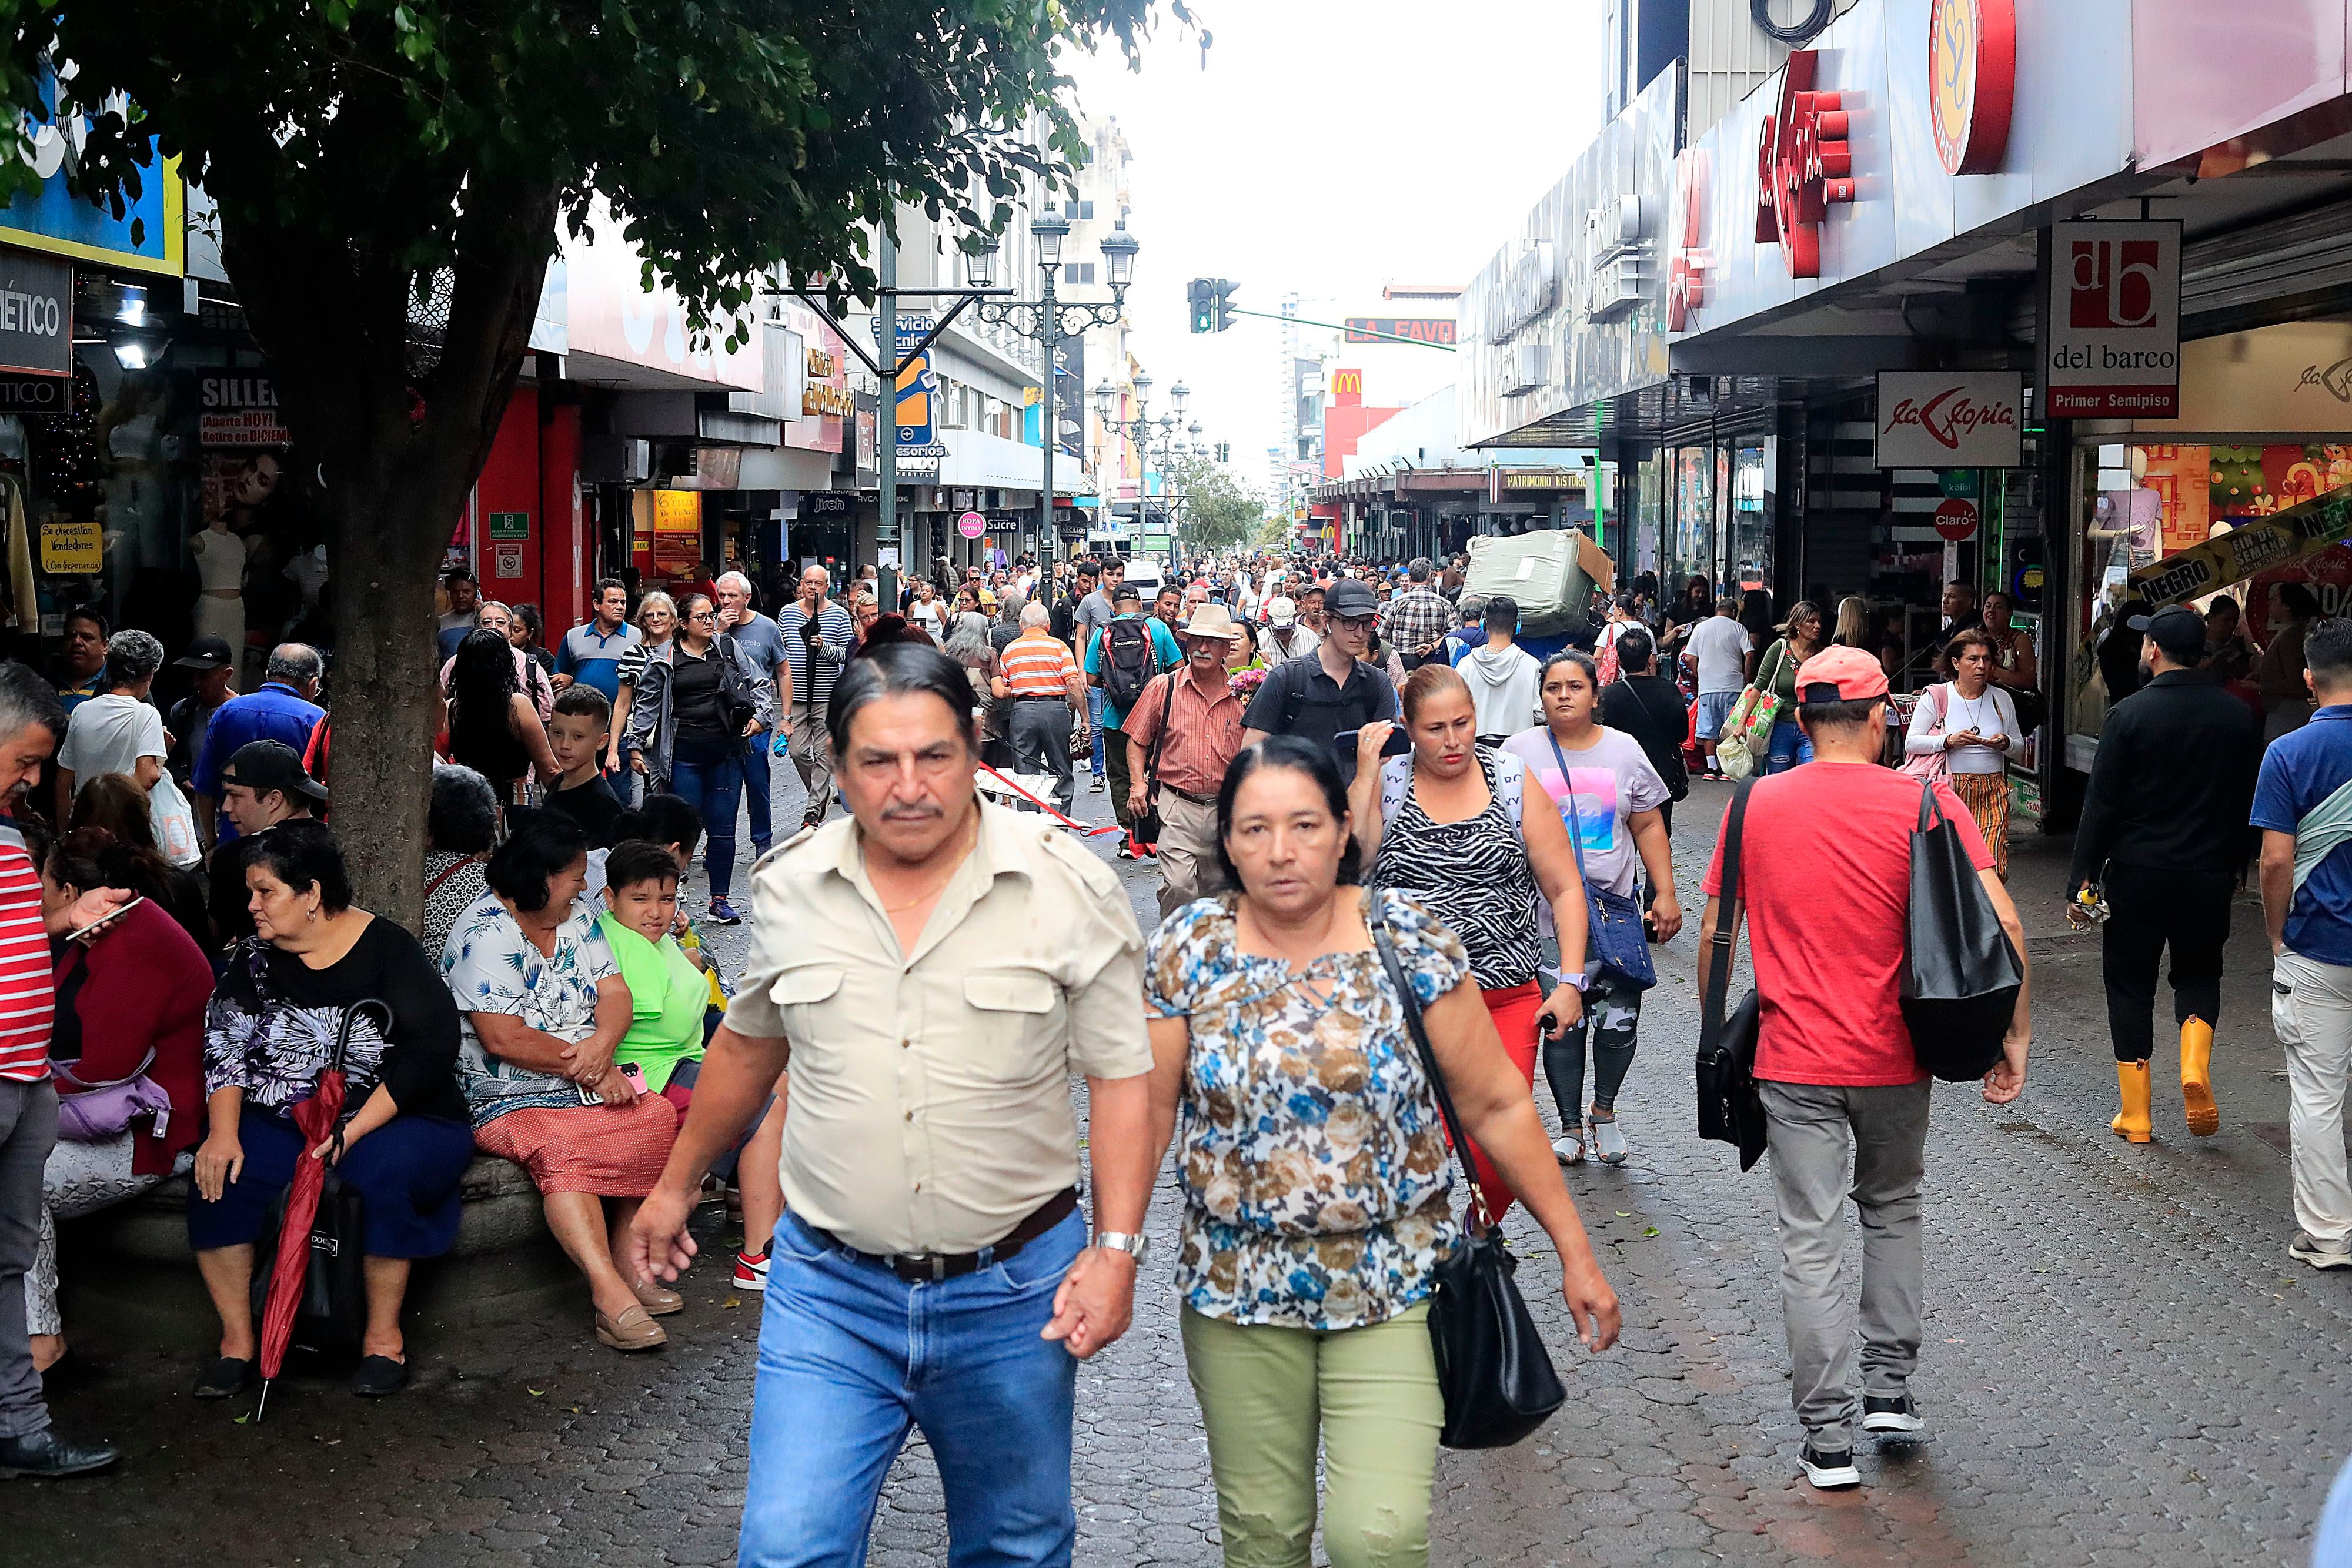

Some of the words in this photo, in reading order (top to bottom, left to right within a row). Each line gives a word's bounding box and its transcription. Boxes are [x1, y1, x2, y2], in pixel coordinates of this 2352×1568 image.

[0, 279, 59, 337] ÉTICO
[1349, 320, 1379, 341] LA
[1395, 320, 1456, 342] FAVO
[2053, 344, 2093, 369] del
[2102, 344, 2174, 369] barco
[2055, 394, 2101, 407] Primer
[2107, 393, 2170, 409] Semipiso
[243, 413, 273, 427] HOY!
[202, 432, 233, 442] Retire
[234, 433, 248, 442] en
[896, 446, 945, 457] esorios
[1507, 475, 1552, 488] PATRIMONIO
[987, 519, 1017, 530] Sucre
[1935, 515, 1970, 526] Claro
[42, 524, 54, 536] Se
[2232, 534, 2253, 553] FIN
[2234, 536, 2288, 566] SEMANA
[2137, 559, 2211, 607] NEGRO
